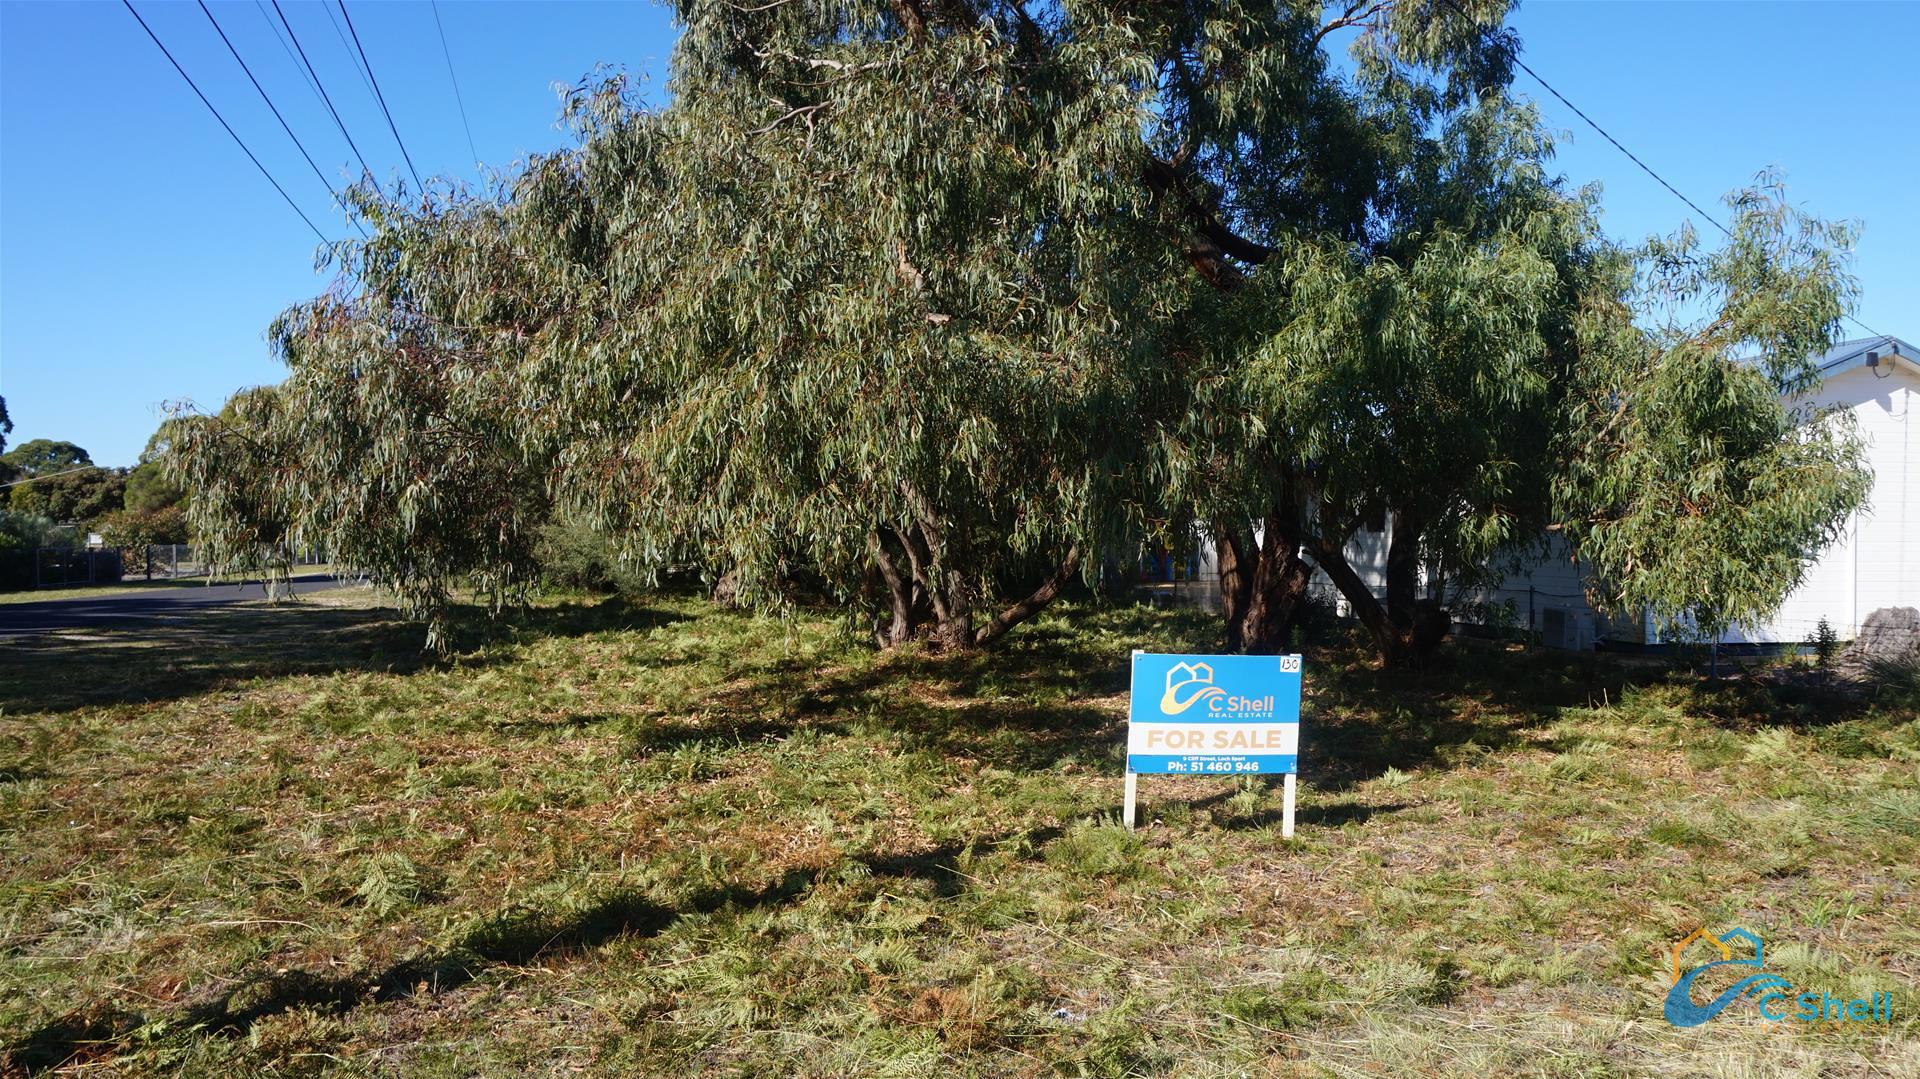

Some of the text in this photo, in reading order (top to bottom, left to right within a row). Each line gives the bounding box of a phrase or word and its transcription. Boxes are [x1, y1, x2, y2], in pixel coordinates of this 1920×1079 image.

[1281, 659, 1298, 670] 130
[1209, 696, 1274, 712] C Shell
[1147, 730, 1282, 749] FOR SALE
[1167, 761, 1259, 771] Ph: 51 460 946
